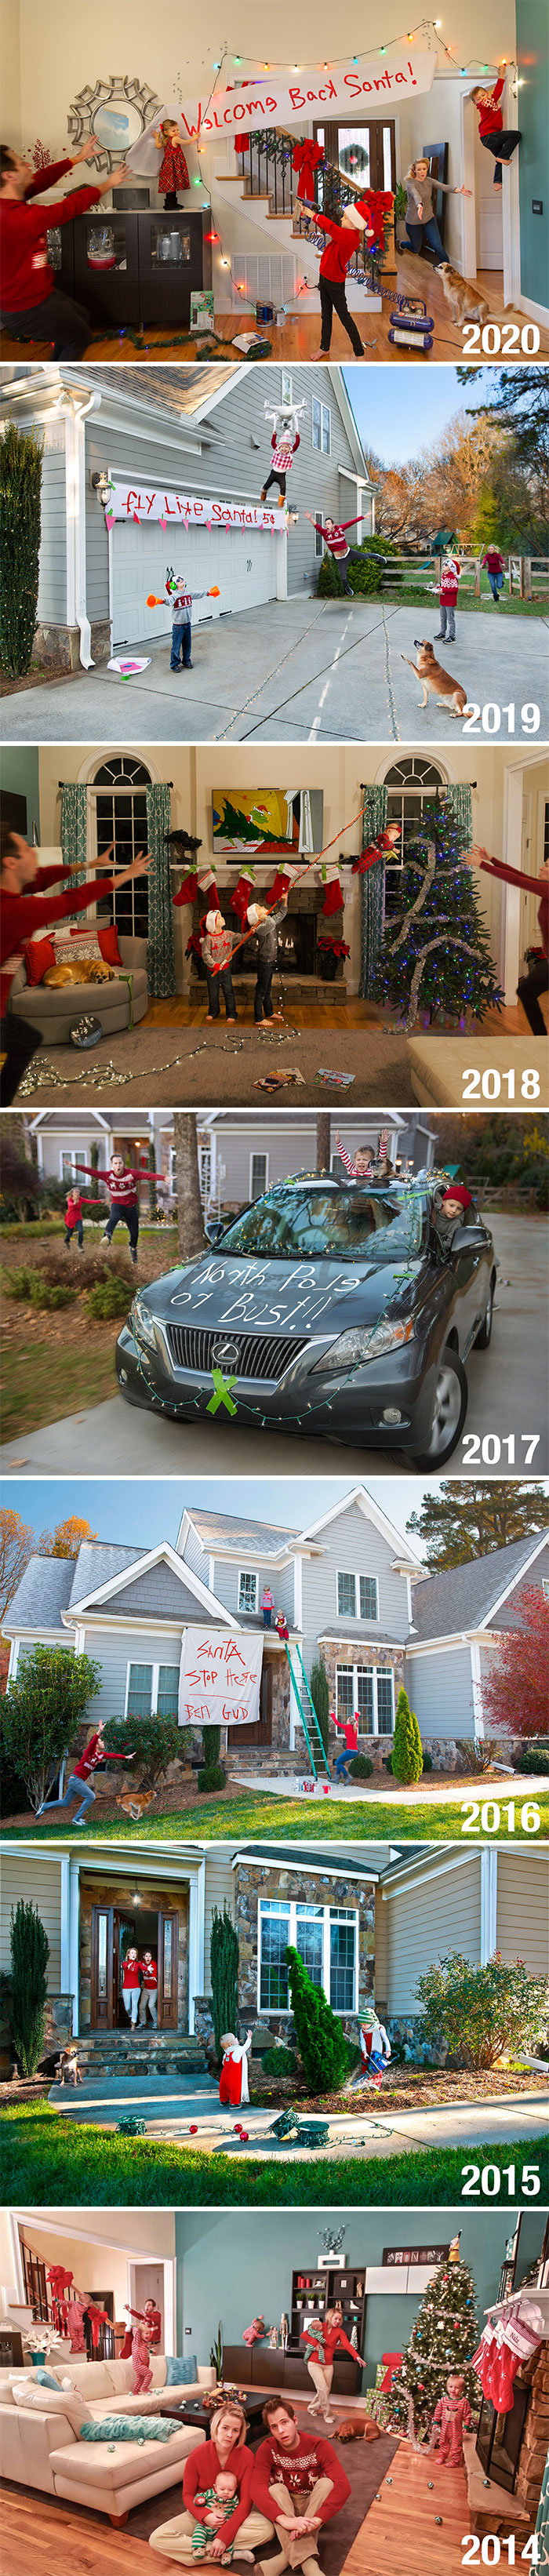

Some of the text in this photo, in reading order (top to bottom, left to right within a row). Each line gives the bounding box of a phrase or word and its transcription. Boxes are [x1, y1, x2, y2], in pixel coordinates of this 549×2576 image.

[181, 62, 417, 137] Welcome Back Santa!
[211, 504, 257, 524] Santa!
[191, 1261, 361, 1292] North Pole
[170, 1293, 332, 1330] or Bust!!
[222, 1703, 249, 1720] GUD
